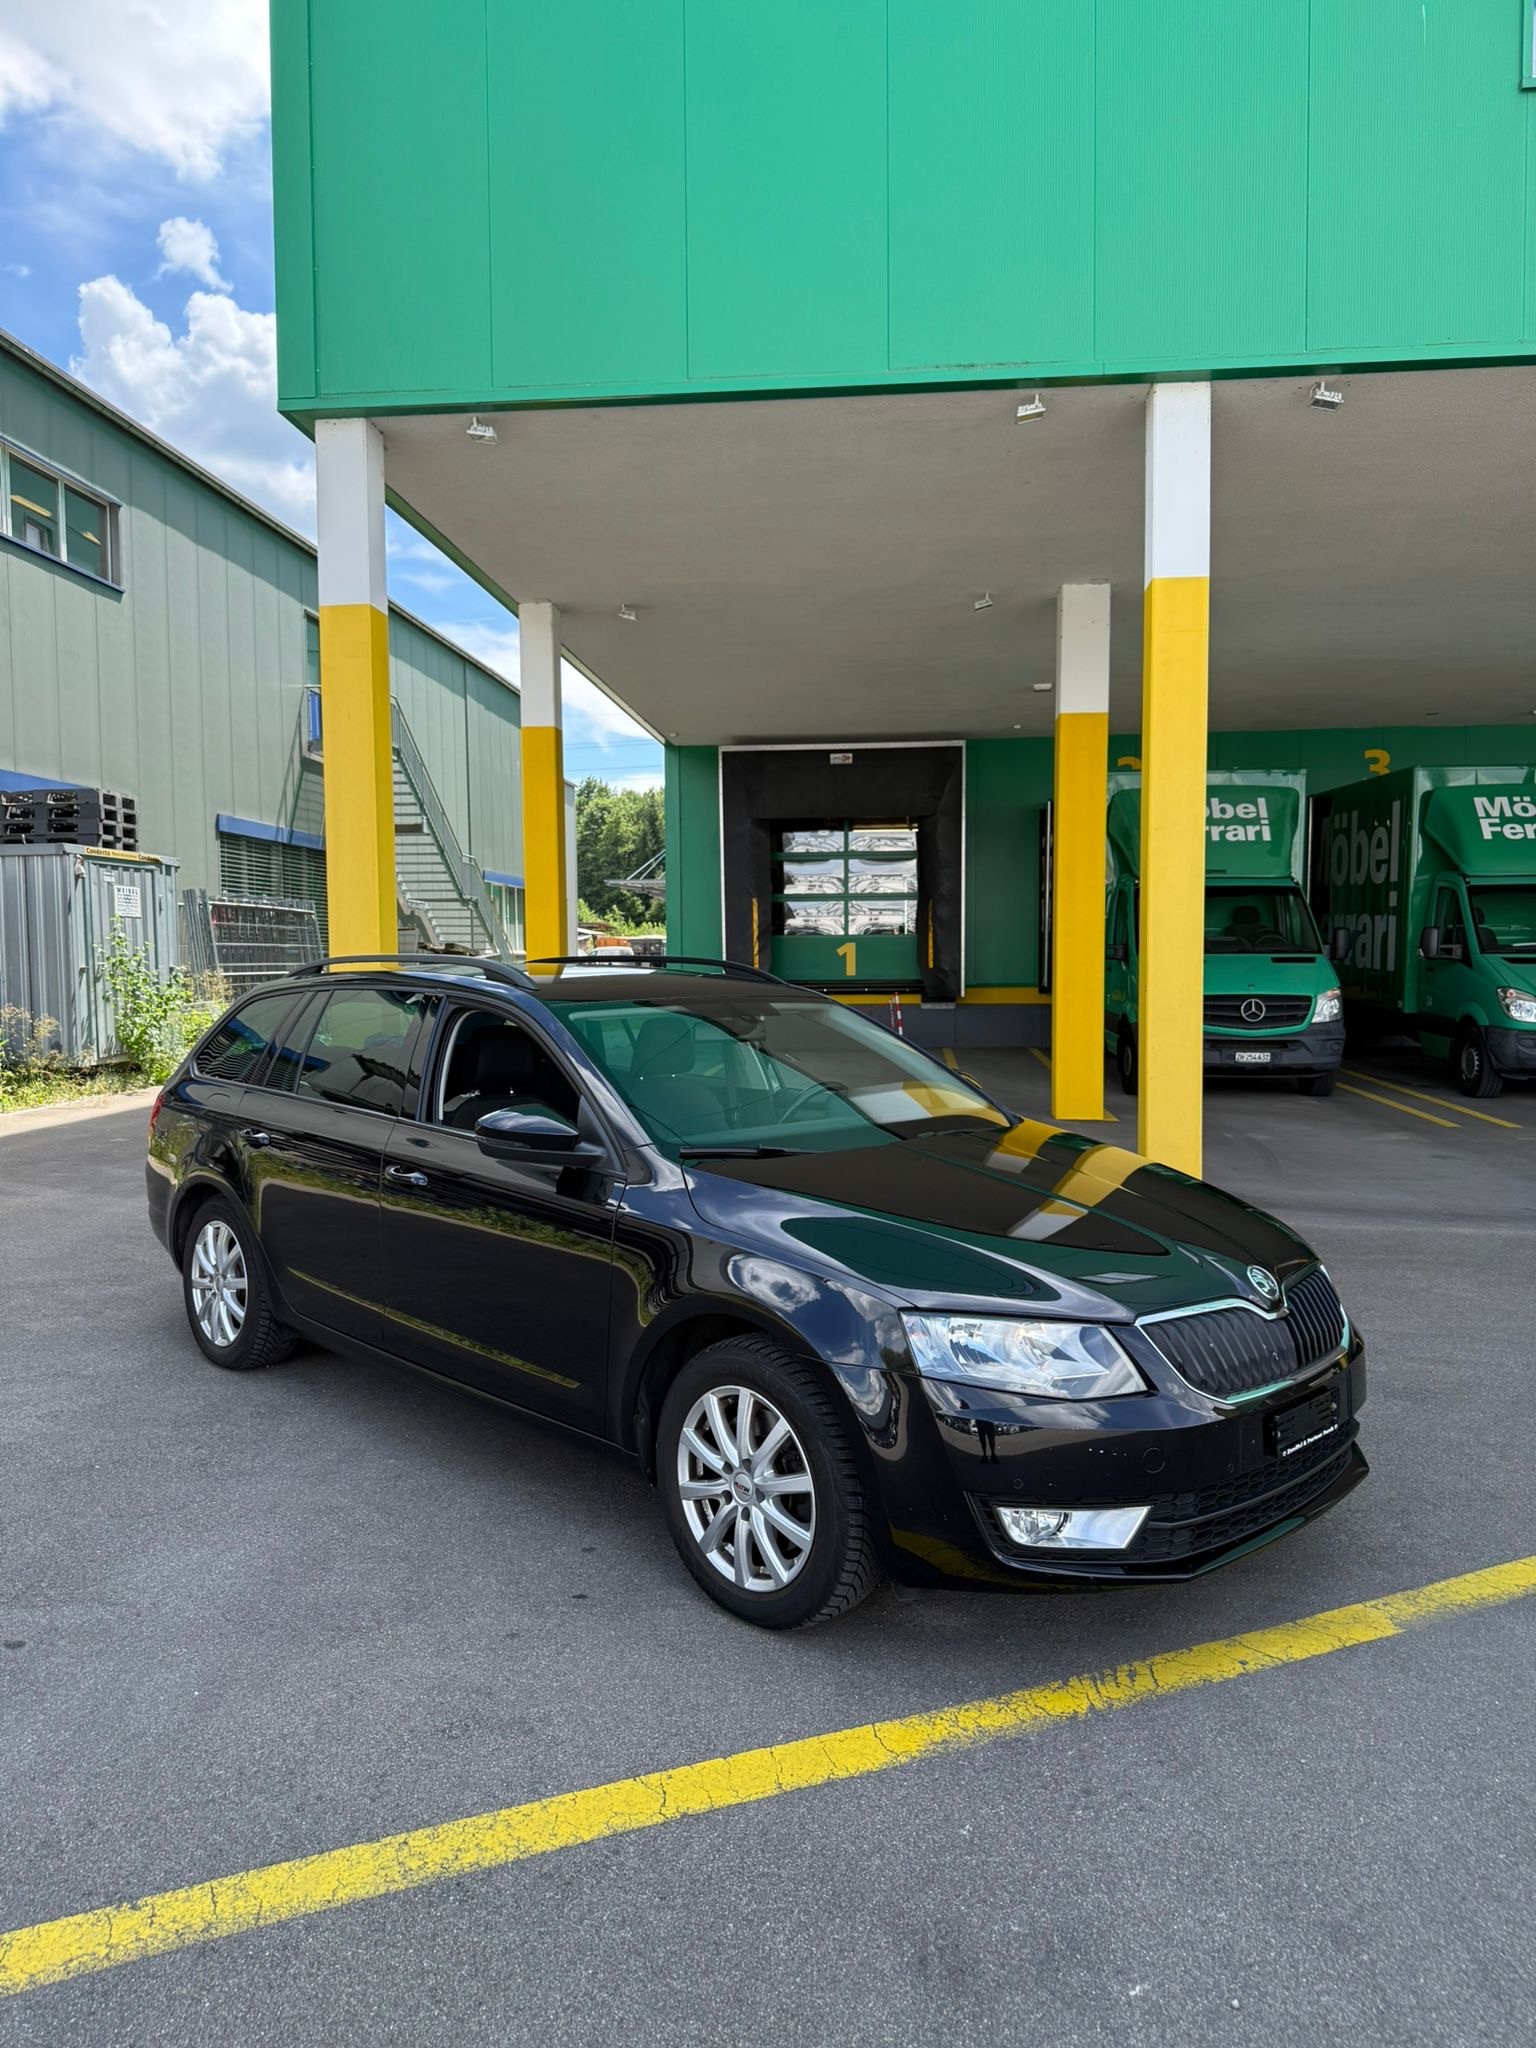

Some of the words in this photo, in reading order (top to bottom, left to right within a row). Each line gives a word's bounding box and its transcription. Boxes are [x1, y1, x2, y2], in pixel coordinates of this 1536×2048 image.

[1364, 749, 1391, 776] 3
[1205, 797, 1268, 819] bel
[1205, 819, 1272, 841] rari
[836, 942, 856, 976] 1
